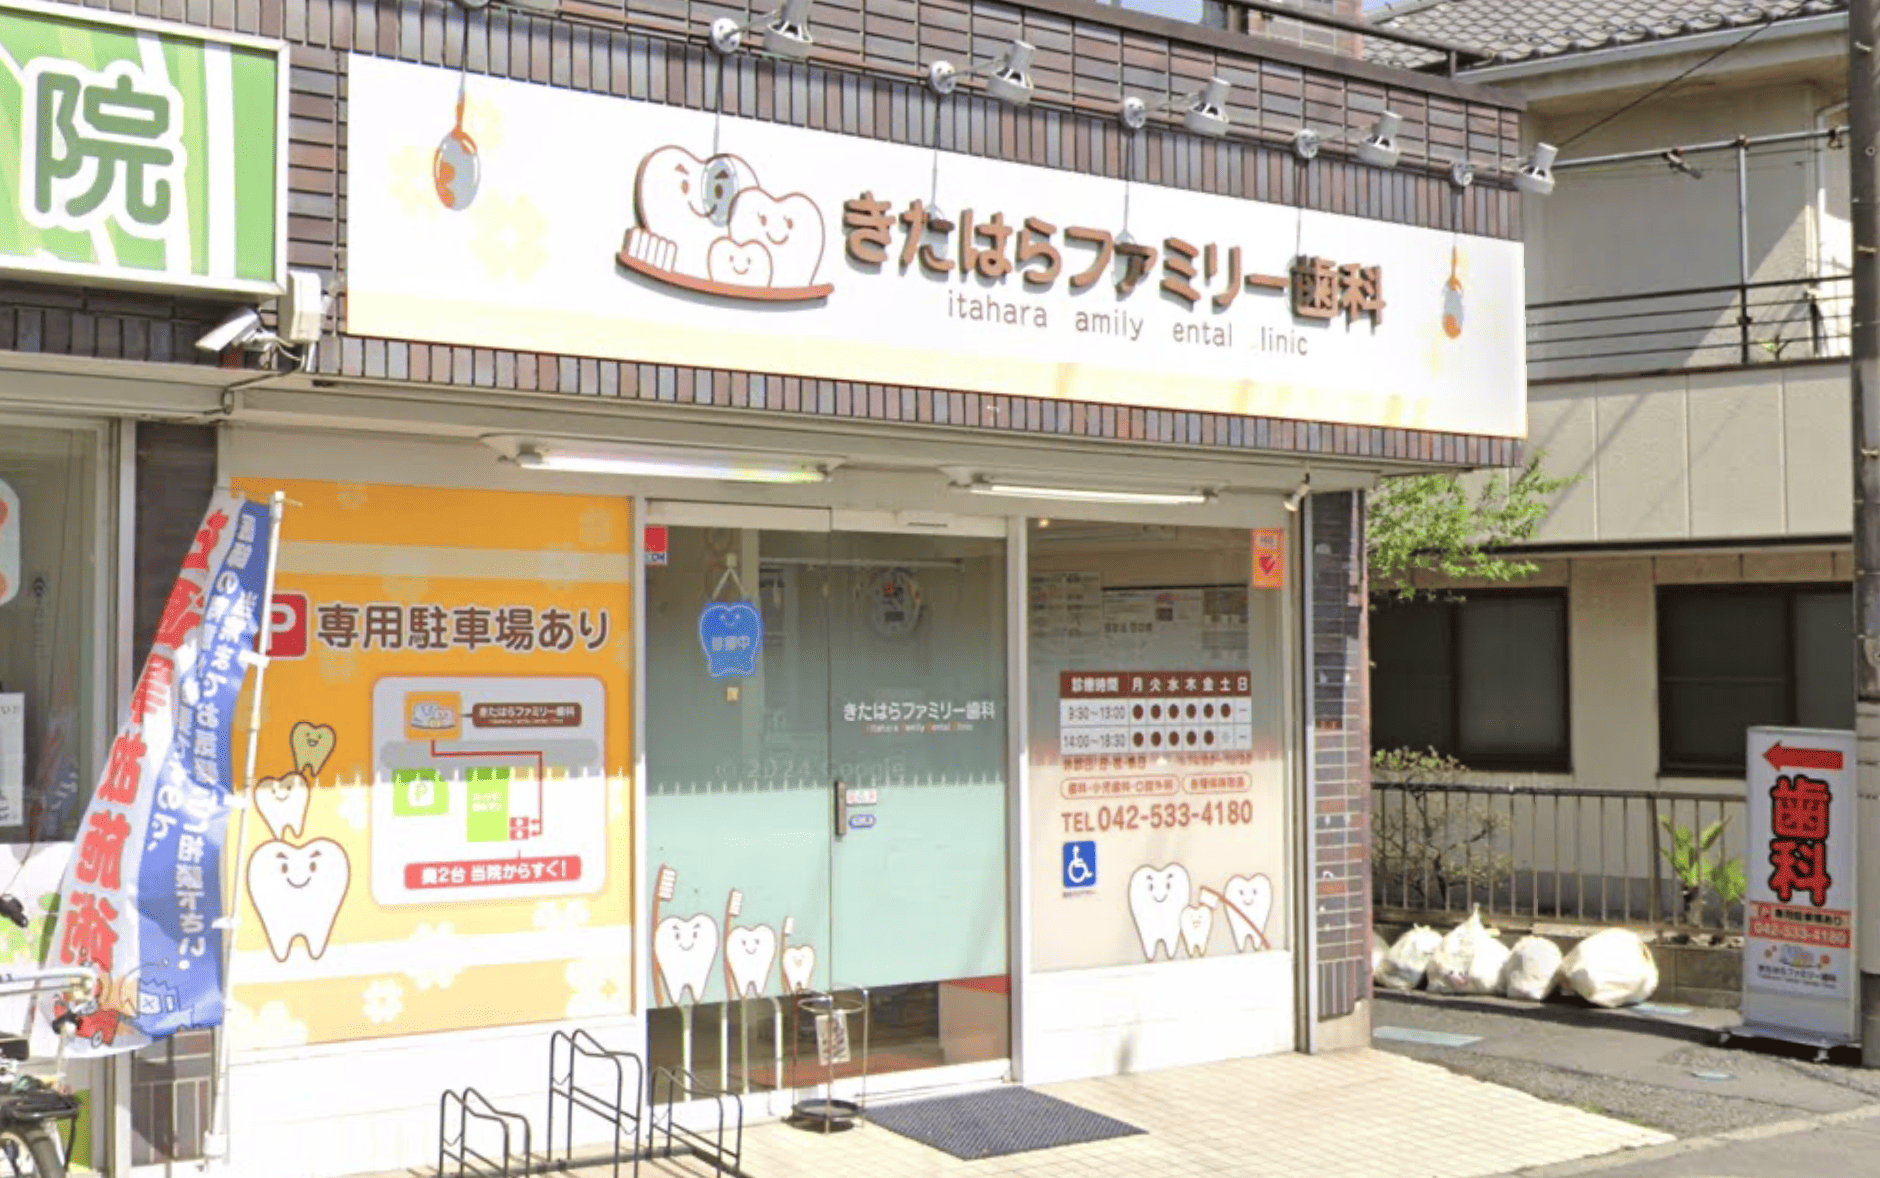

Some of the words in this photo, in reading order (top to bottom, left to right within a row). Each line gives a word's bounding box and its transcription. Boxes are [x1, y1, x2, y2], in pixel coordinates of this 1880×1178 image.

[34, 71, 173, 225] 院
[843, 192, 1386, 332] きたはらファミリー歯科
[318, 604, 610, 650] 専用駐車場あり
[1132, 677, 1143, 692] 月
[1150, 677, 1161, 692] 火
[1203, 677, 1214, 692] 金
[1220, 677, 1231, 692] 土
[1237, 677, 1248, 692] 日
[843, 701, 996, 721] きたはらファミリー歯科
[1061, 812, 1095, 833] TEL
[1098, 799, 1253, 832] 042-533-4180
[1769, 775, 1832, 906] 歯科
